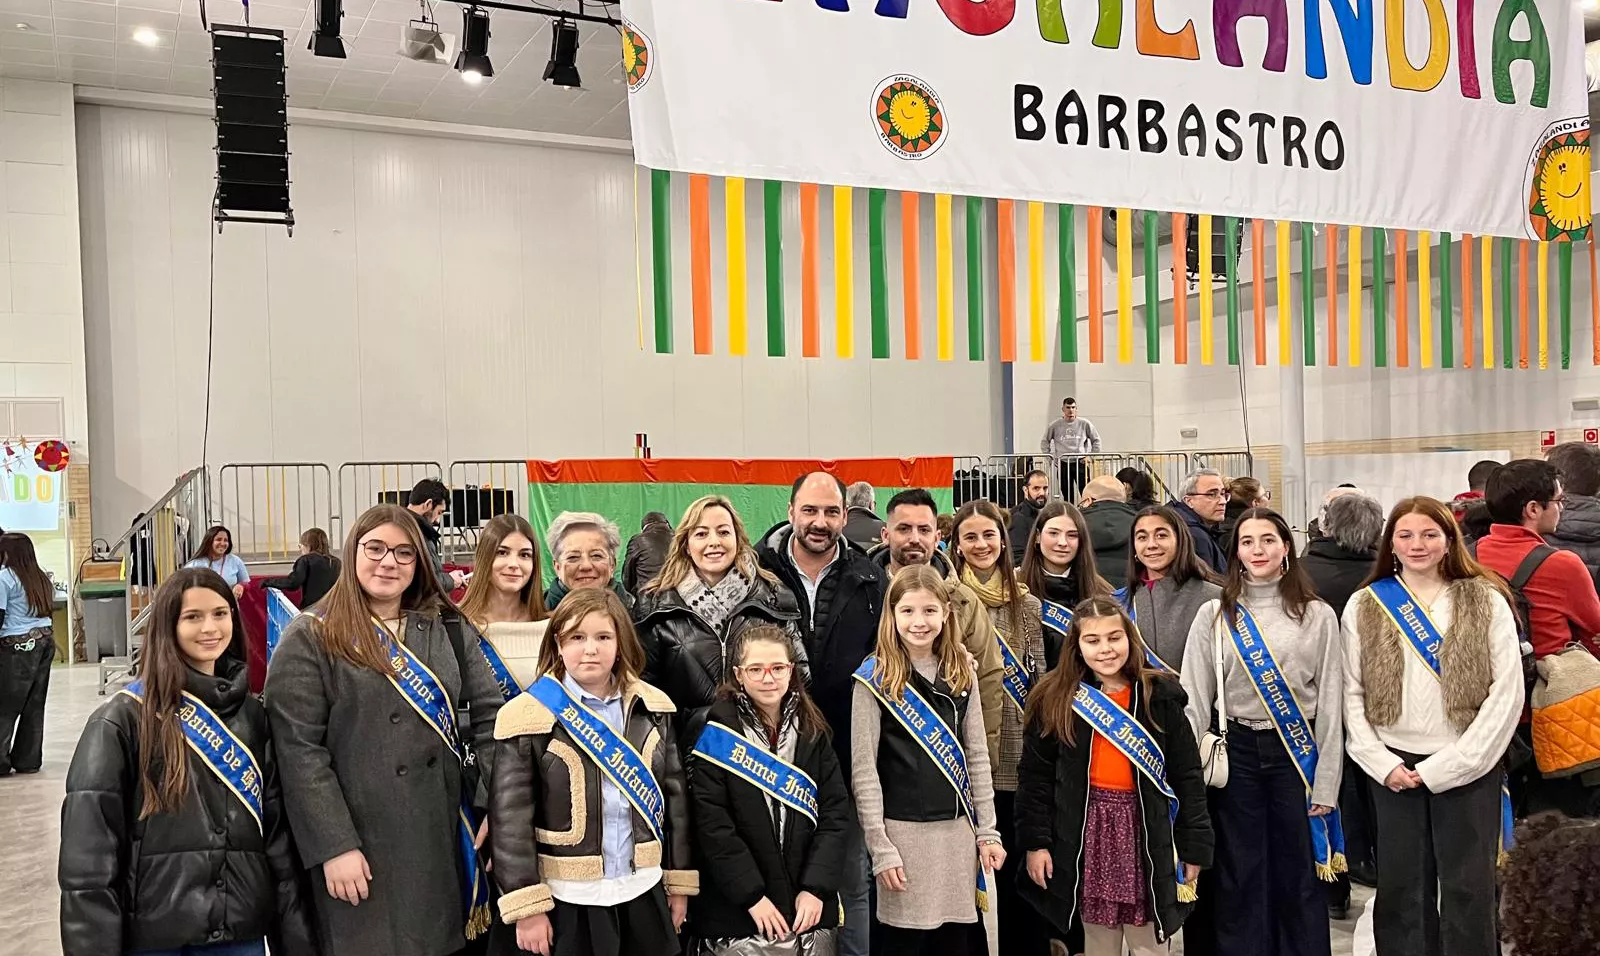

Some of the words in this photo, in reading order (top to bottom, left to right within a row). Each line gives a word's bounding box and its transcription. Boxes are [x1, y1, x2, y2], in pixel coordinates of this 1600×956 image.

[1014, 83, 1345, 171] BARBASTRO
[1398, 600, 1431, 642] Dama
[1004, 661, 1028, 699] Hono
[1250, 648, 1265, 667] de
[1260, 668, 1291, 717] Honor
[1286, 719, 1313, 756] 2024
[178, 701, 224, 752] Dama
[222, 744, 242, 772] de
[560, 702, 607, 753] Dama
[604, 747, 657, 815] Infantil
[728, 741, 778, 786] Dama
[895, 698, 927, 732] ama
[924, 726, 966, 790] Infantil
[1073, 684, 1116, 729] Dama
[1112, 722, 1164, 779] Infantil
